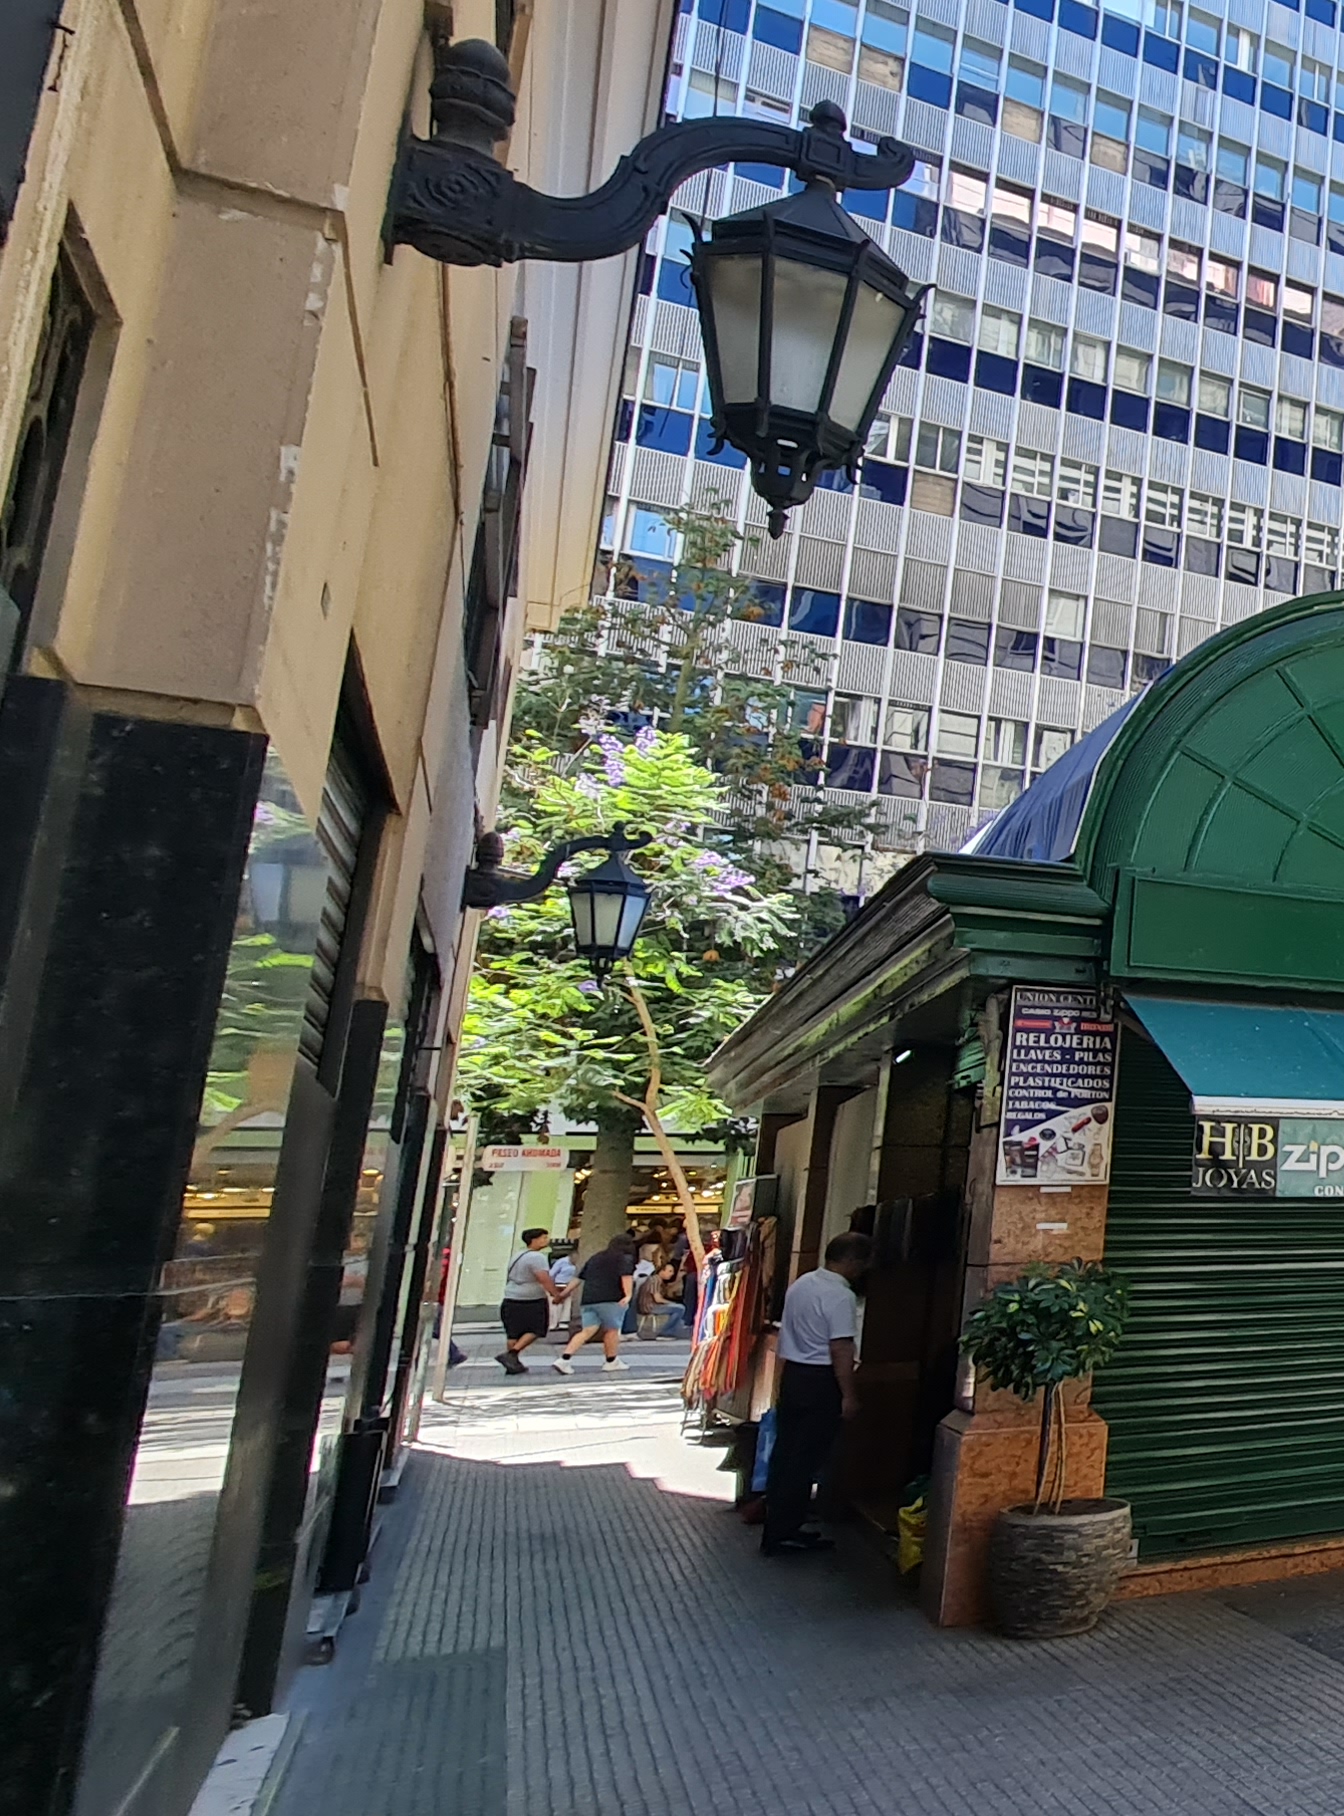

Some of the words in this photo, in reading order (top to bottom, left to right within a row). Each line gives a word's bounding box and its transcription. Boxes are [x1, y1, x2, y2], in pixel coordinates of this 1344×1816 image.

[1016, 991, 1056, 1002] UNION
[1015, 1032, 1112, 1049] RELOJERIA
[1012, 1049, 1062, 1060] LLAVES
[1074, 1051, 1112, 1062] PILAS
[1011, 1062, 1111, 1075] ENCENDEDORES
[1010, 1076, 1110, 1088] PLASTIFICADOS
[1008, 1088, 1053, 1098] CONTROL
[1056, 1090, 1068, 1098] de
[1193, 1168, 1275, 1189] JOYAS
